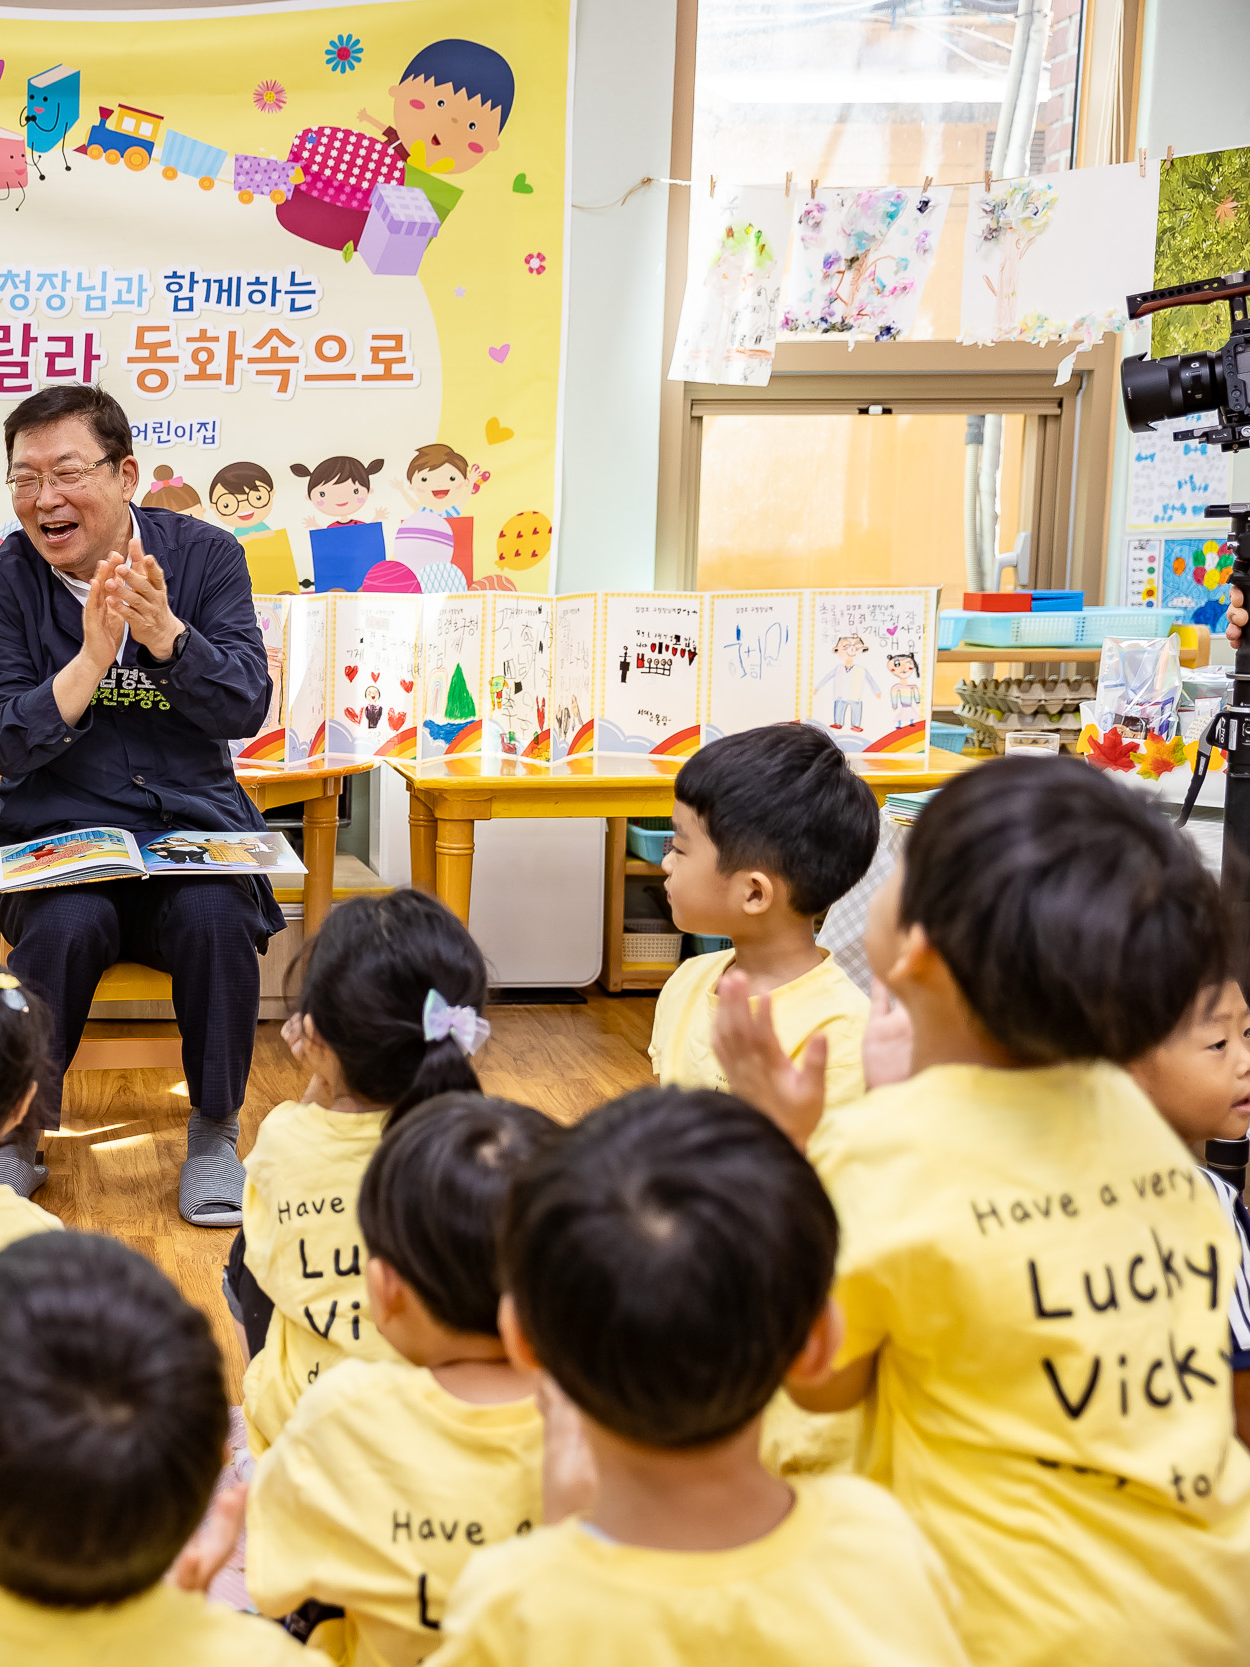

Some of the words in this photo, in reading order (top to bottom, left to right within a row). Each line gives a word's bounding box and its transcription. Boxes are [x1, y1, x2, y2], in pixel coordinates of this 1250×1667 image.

[163, 269, 318, 313] 함께하는
[127, 323, 415, 394] 동화속으로
[130, 420, 217, 445] 어린이집
[277, 1196, 345, 1224] Have
[971, 1191, 1079, 1237] Have
[1100, 1183, 1119, 1207] a
[1132, 1166, 1197, 1202] very
[1027, 1224, 1219, 1320] Lucky
[391, 1509, 486, 1546] Have
